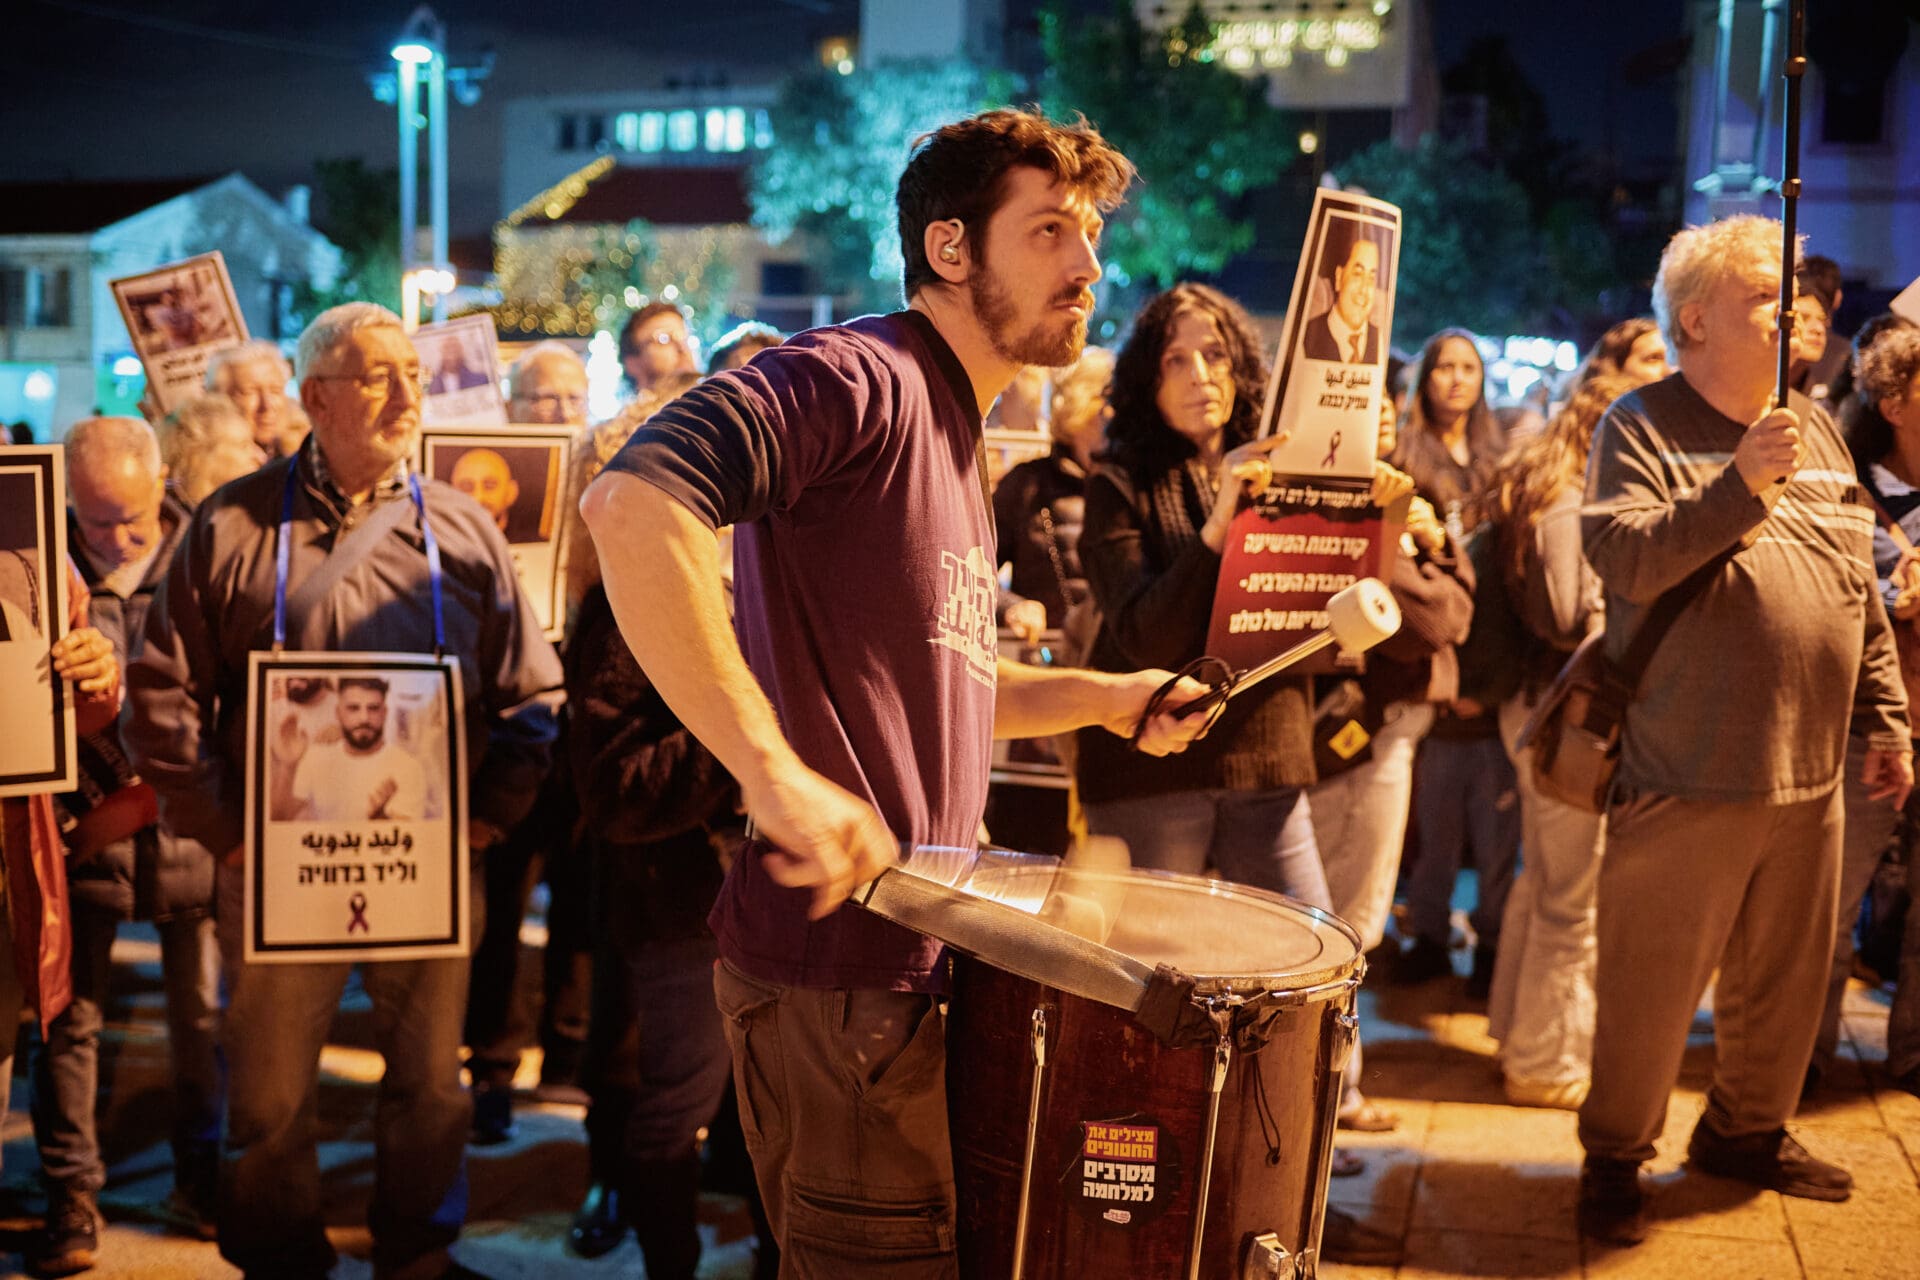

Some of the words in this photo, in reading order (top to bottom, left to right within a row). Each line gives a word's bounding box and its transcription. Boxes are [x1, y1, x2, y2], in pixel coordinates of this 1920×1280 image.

[367, 826, 413, 854] وليد
[299, 864, 365, 884] בדוויה
[372, 860, 416, 883] וליד
[1088, 1126, 1107, 1139] את
[1109, 1128, 1154, 1142] מצילים
[1087, 1140, 1154, 1158] החטופים
[1084, 1160, 1155, 1182] מסרבים
[1083, 1181, 1154, 1201] למלחמה
